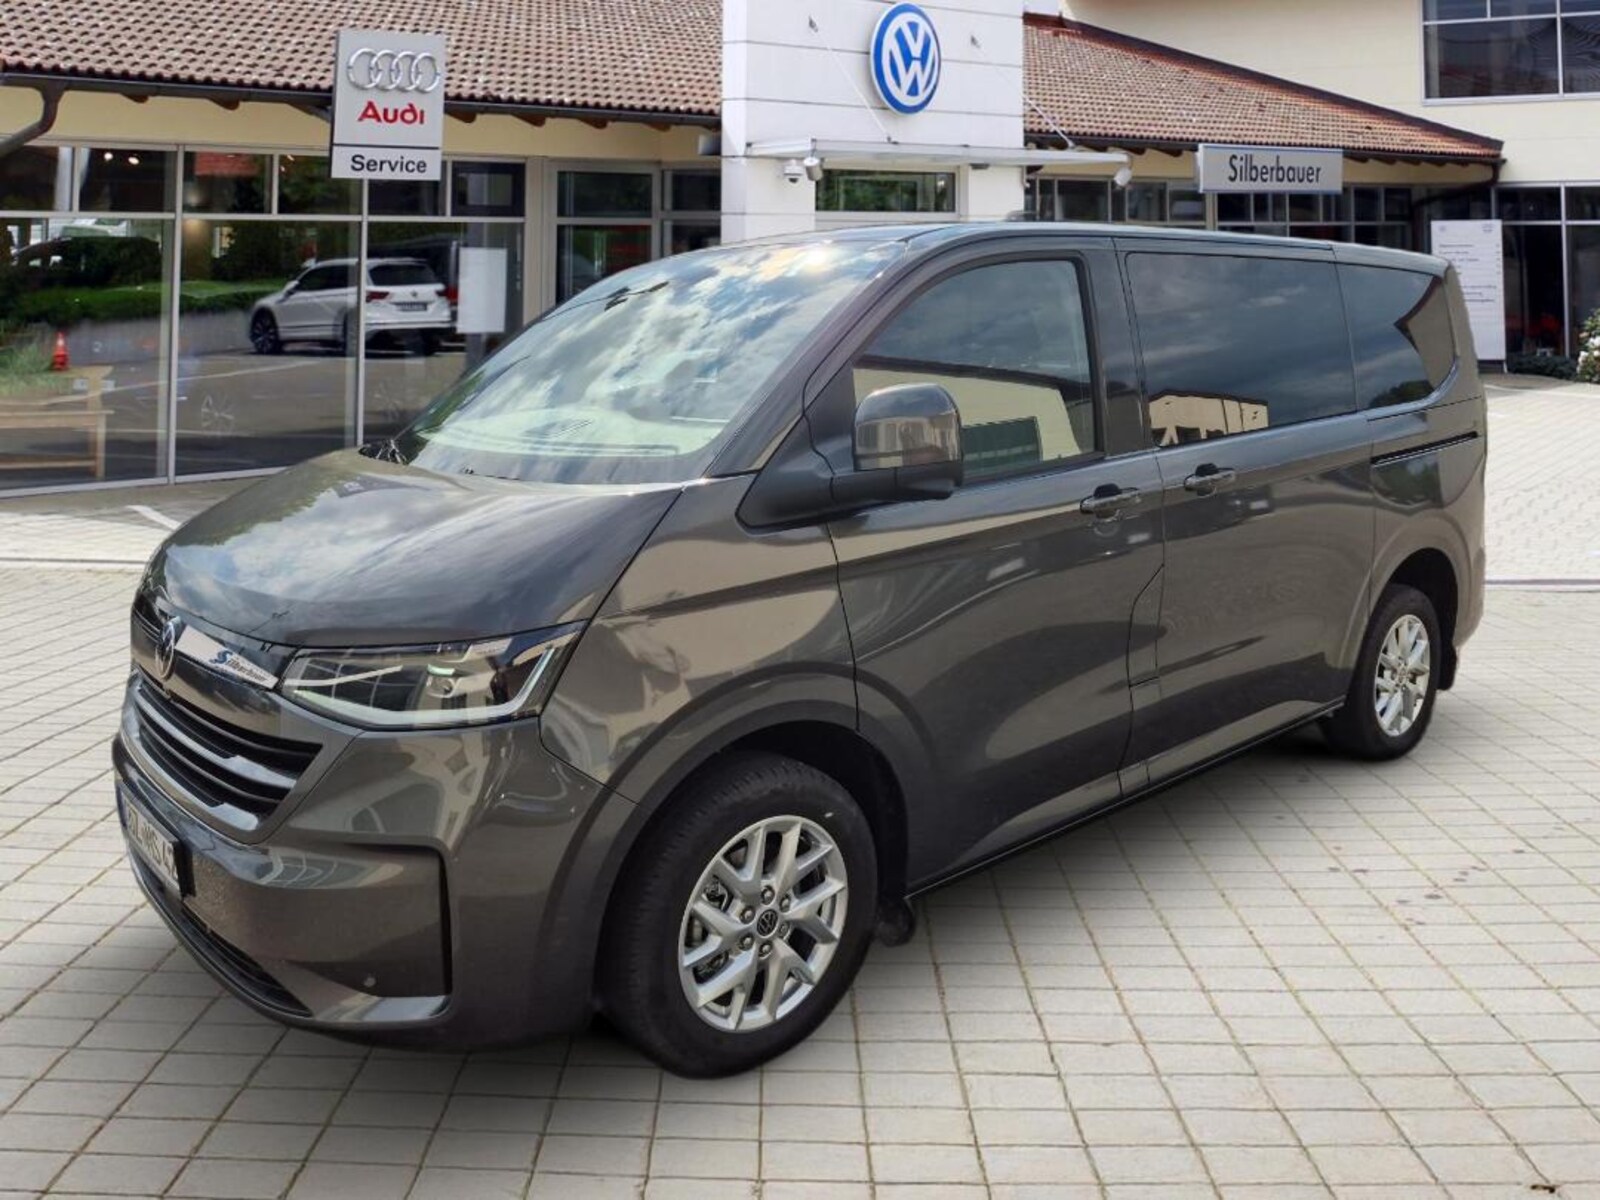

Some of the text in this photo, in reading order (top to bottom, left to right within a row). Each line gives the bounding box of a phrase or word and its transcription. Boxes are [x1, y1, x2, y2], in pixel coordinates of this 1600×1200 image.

[358, 100, 425, 125] Audi
[351, 154, 428, 173] Service
[1228, 154, 1321, 183] Silberbauer
